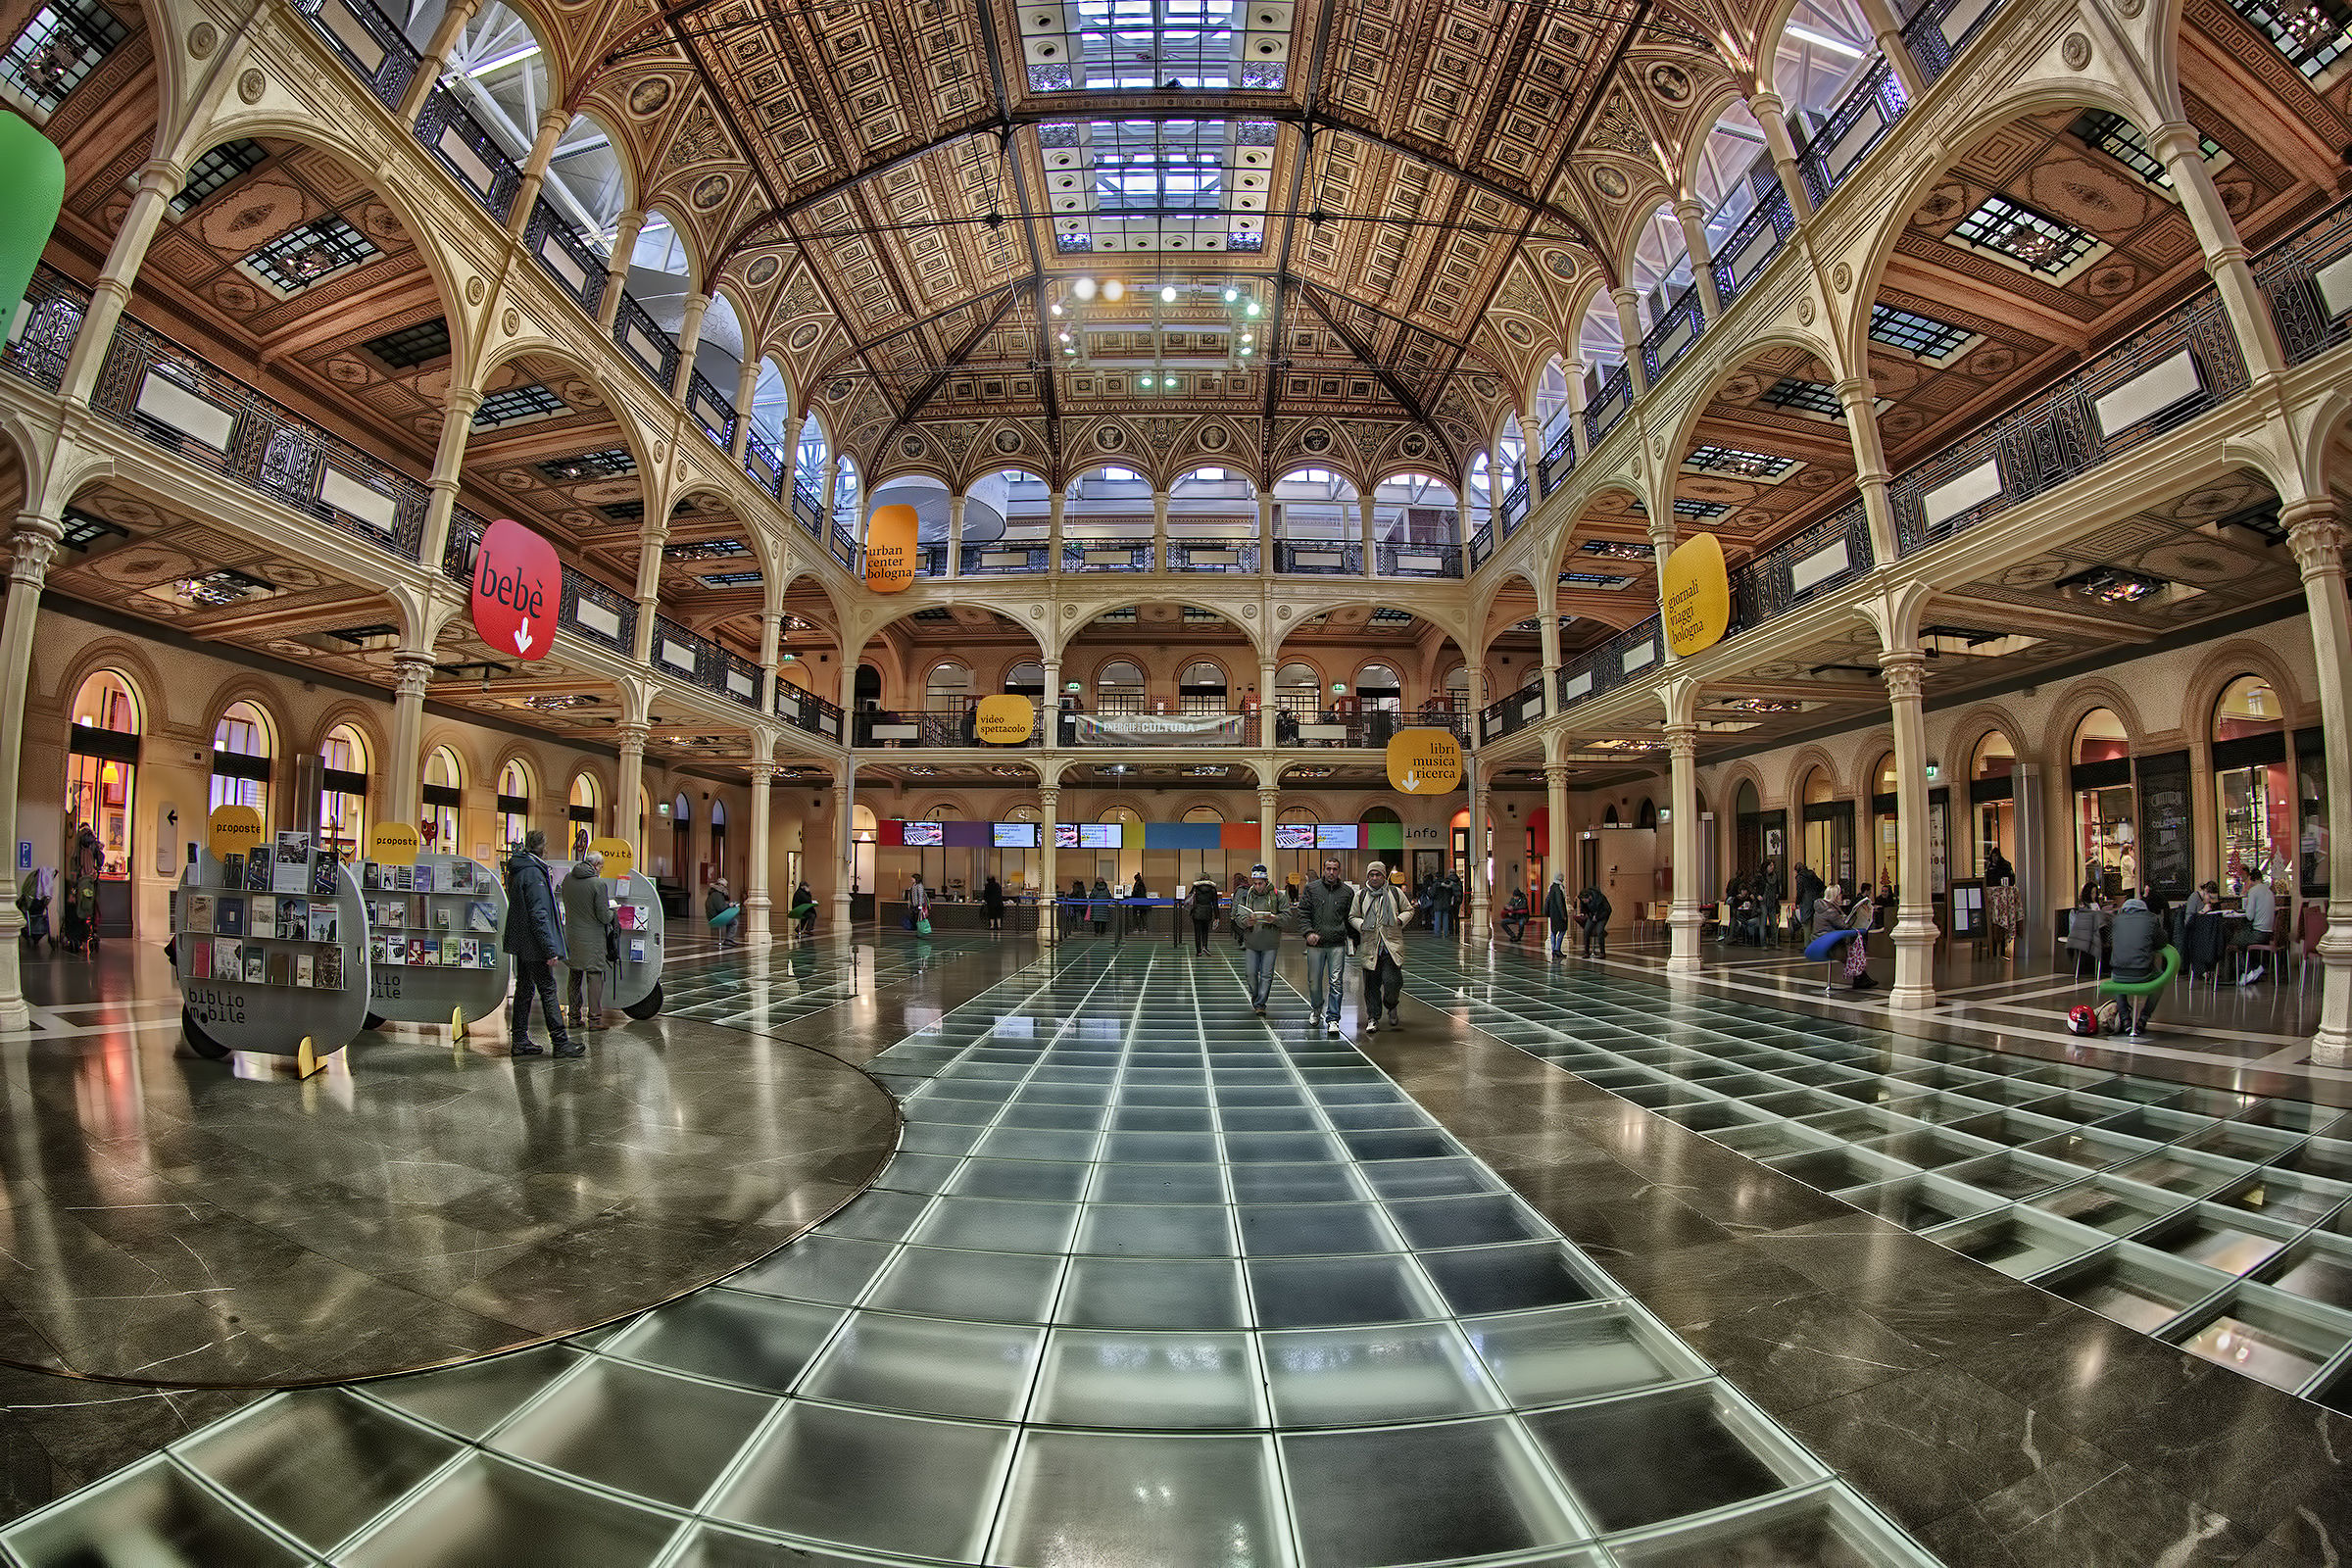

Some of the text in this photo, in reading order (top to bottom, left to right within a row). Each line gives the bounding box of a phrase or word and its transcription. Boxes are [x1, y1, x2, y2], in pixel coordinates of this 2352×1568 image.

[868, 545, 903, 557] urban
[867, 558, 904, 568] center
[867, 567, 912, 581] bologna
[479, 550, 543, 618] bebè
[1668, 578, 1699, 612] giornali
[1670, 601, 1694, 626] viaggi
[1672, 620, 1704, 644] bologna
[980, 714, 1004, 724] video
[980, 724, 1026, 735] spettacolo
[1103, 722, 1137, 732] ENERGIE
[1141, 722, 1196, 733] CULTURA
[1430, 742, 1455, 755] libri
[1413, 755, 1455, 766] musica
[1416, 767, 1455, 779] ricerca
[217, 822, 261, 834] proposte
[1405, 827, 1438, 839] info
[376, 837, 417, 847] proposte
[370, 972, 401, 986] lio
[188, 987, 244, 1008] biblio
